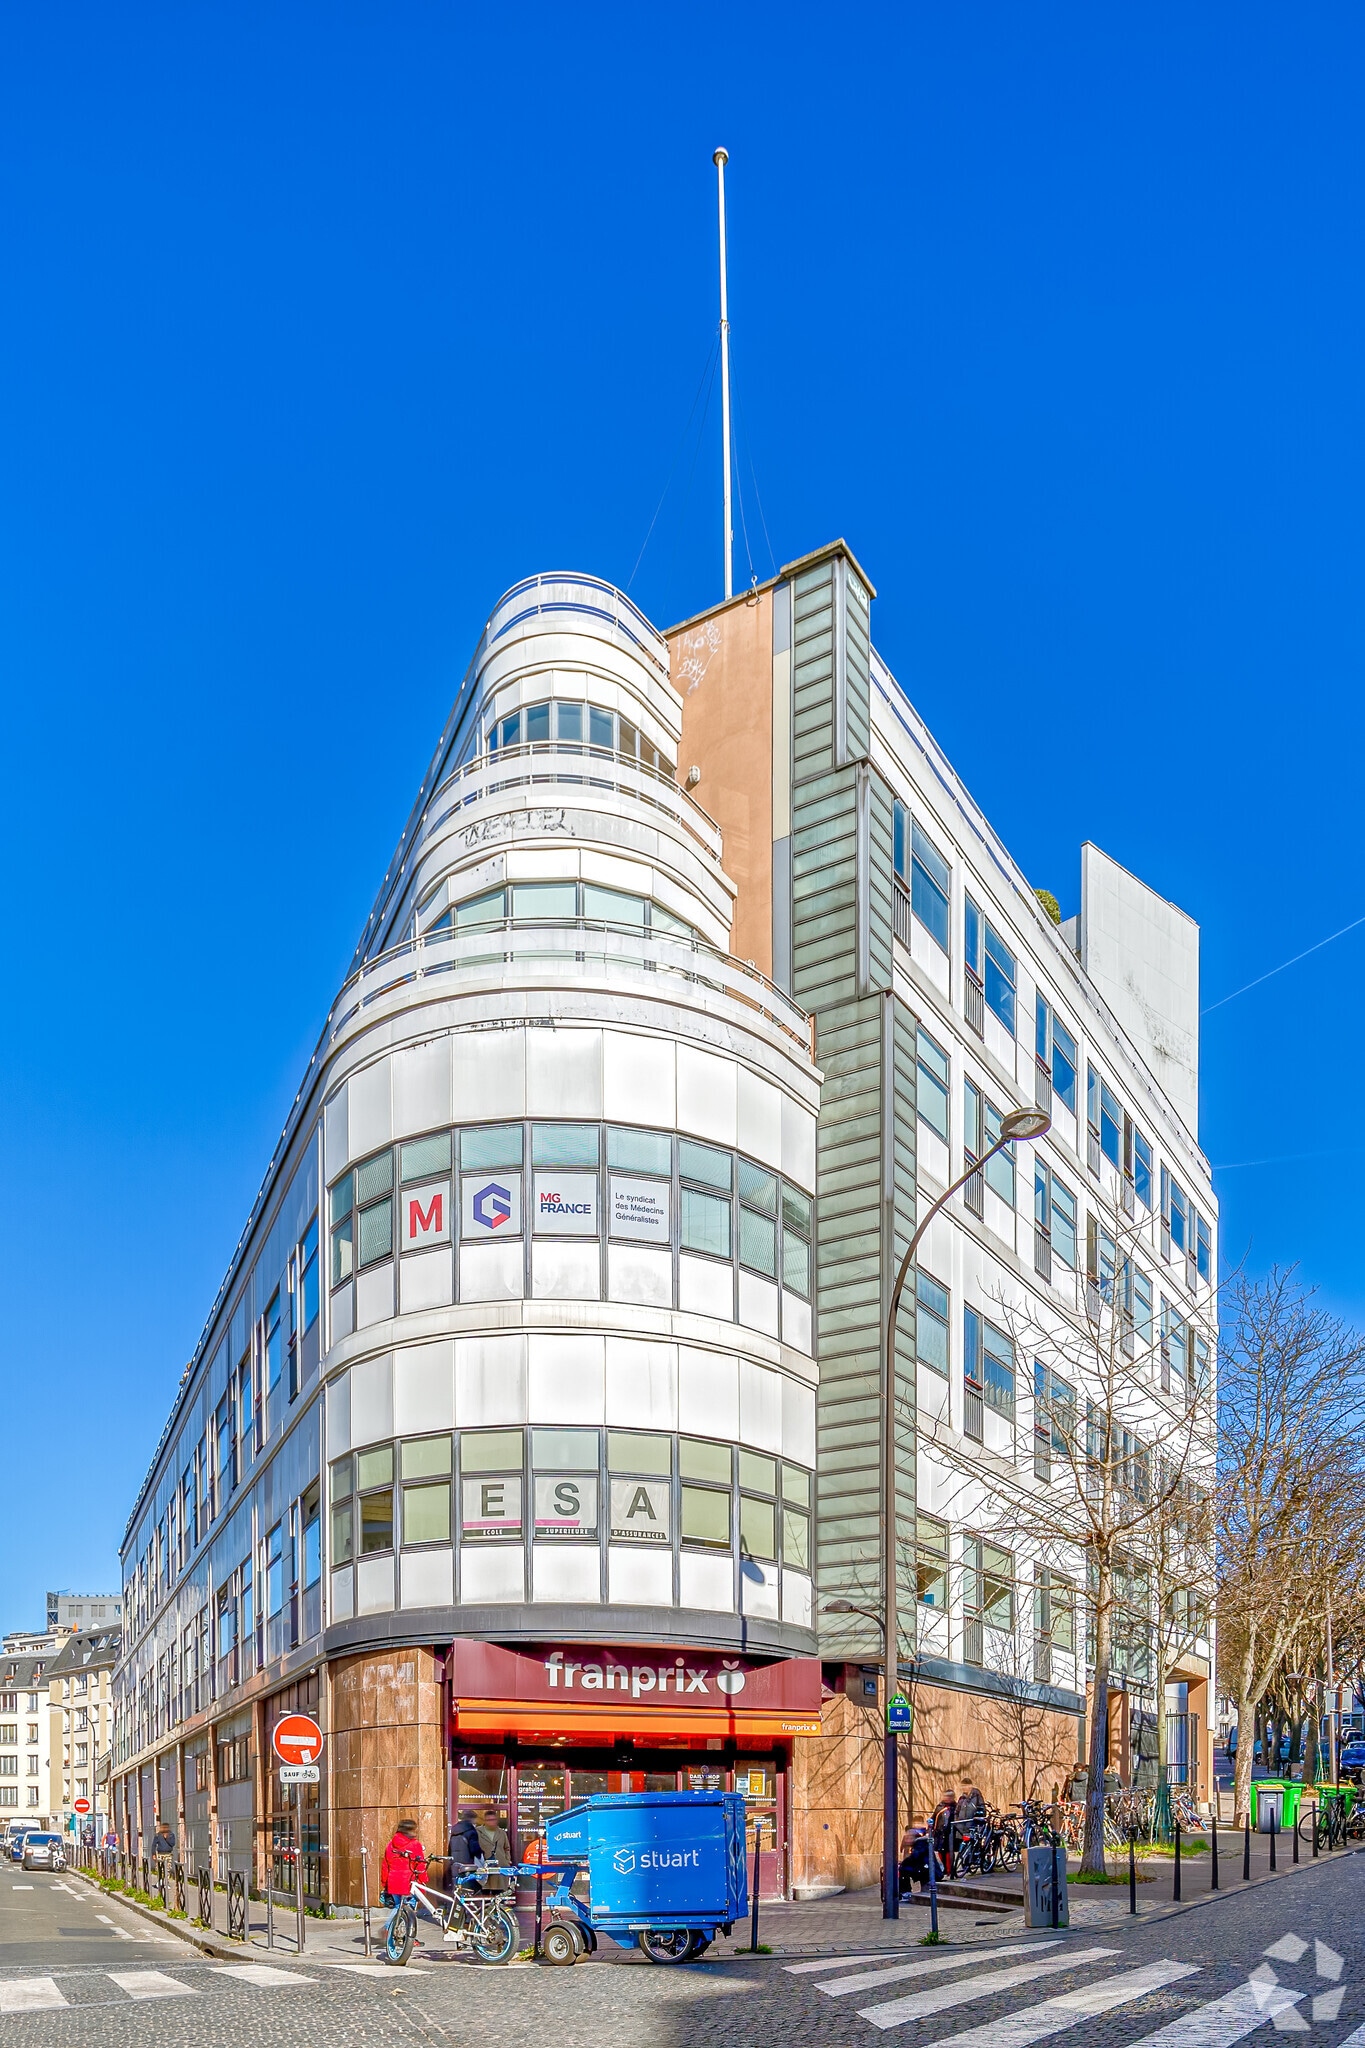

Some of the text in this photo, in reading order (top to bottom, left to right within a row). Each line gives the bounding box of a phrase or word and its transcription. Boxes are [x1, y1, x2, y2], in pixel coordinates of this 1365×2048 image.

[540, 1192, 561, 1203] MG
[615, 1192, 656, 1205] Le syndicat
[410, 1182, 511, 1238] M G
[540, 1203, 592, 1214] FRANCE
[615, 1202, 665, 1216] des Médecins
[615, 1212, 660, 1225] Généralistes
[481, 1482, 657, 1520] E S A
[482, 1527, 664, 1539] ECOLE SUPERIEURE D'ASSURANCES
[544, 1651, 710, 1699] franprix
[781, 1722, 811, 1731] franprix
[460, 1755, 477, 1767] 14
[562, 1831, 582, 1839] stuart
[640, 1849, 700, 1869] stuart
